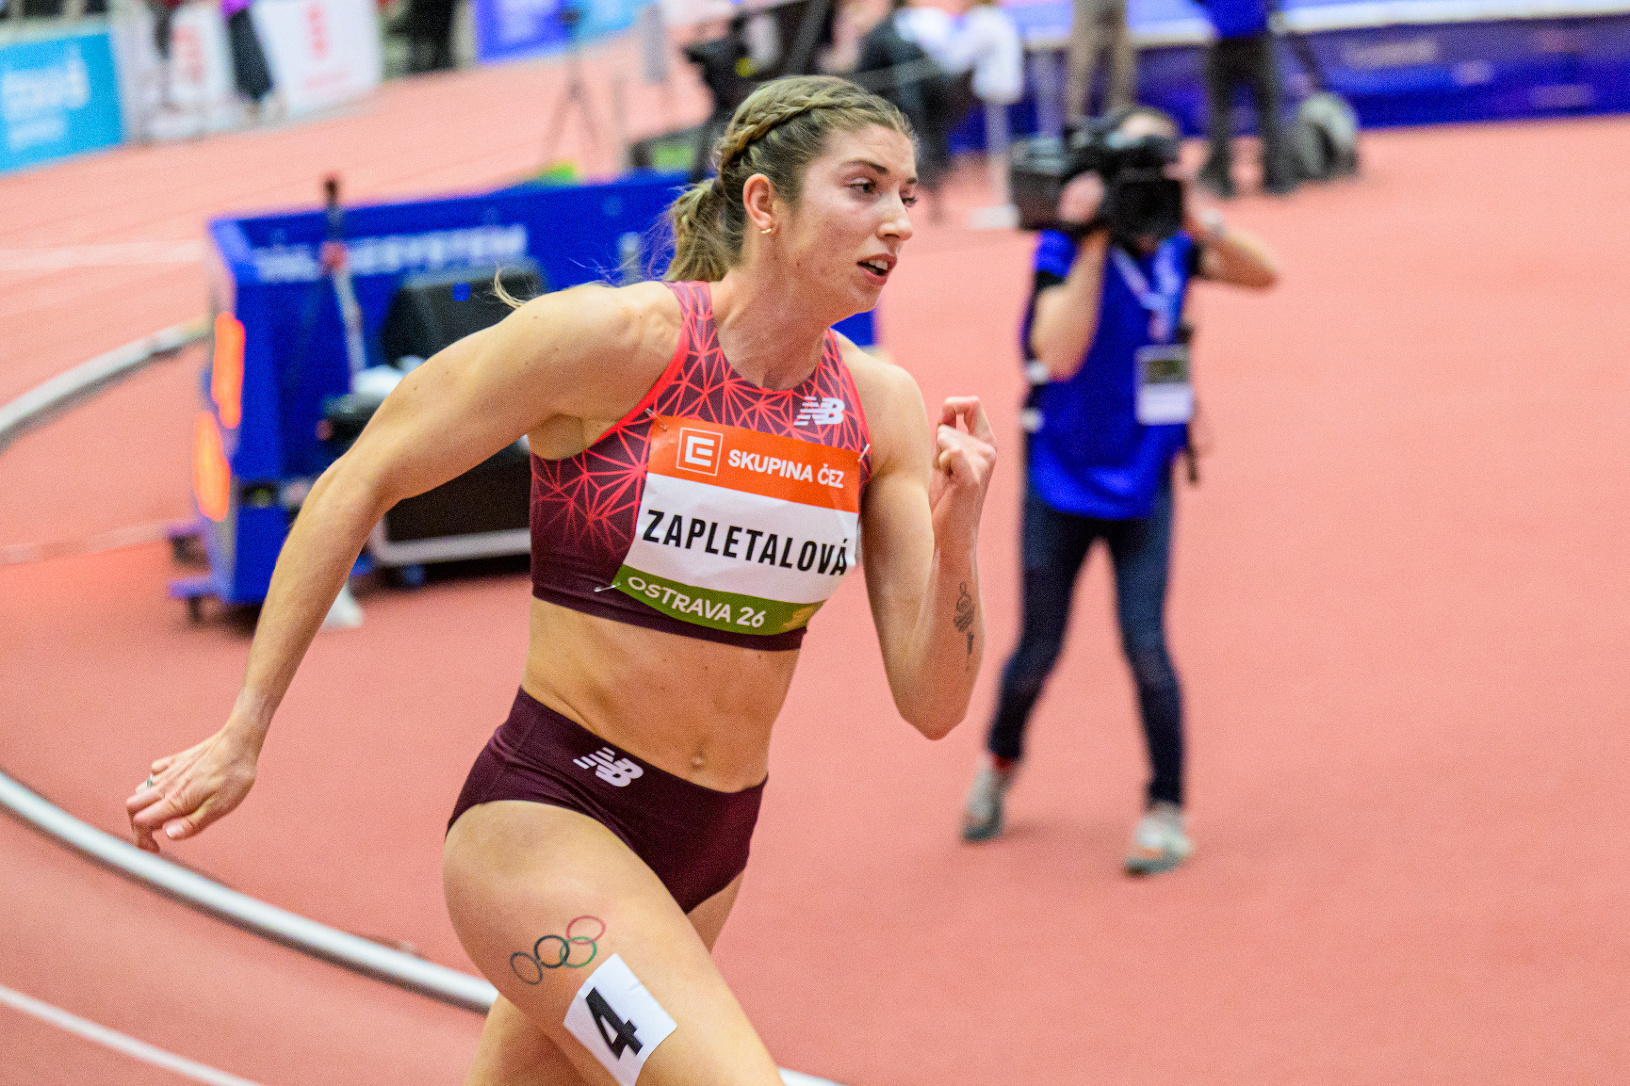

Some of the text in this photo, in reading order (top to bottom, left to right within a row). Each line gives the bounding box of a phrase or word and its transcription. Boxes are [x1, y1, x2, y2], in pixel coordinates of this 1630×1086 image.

[728, 449, 813, 483] SKUPINA
[817, 463, 844, 488] ČEZ
[642, 509, 848, 576] ZAPLETALOVÁ
[627, 576, 765, 628] OSTRAVA 26
[585, 986, 643, 1060] 4
